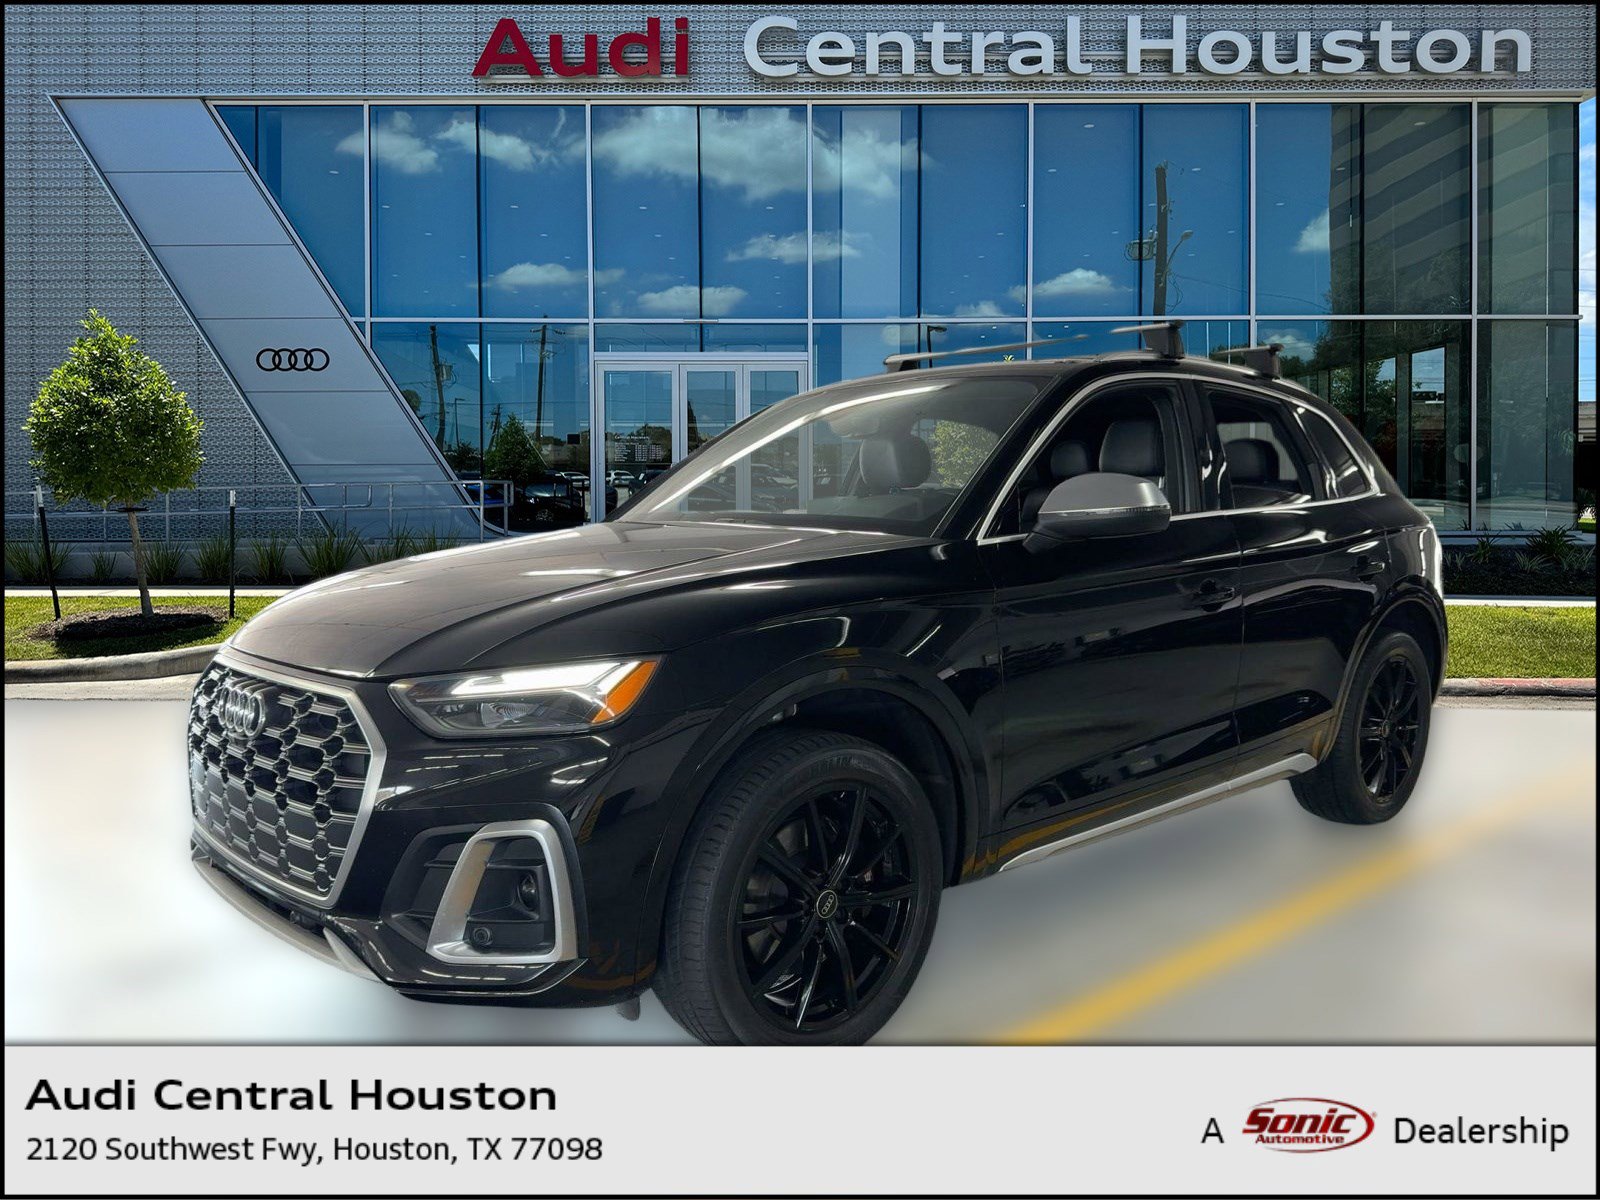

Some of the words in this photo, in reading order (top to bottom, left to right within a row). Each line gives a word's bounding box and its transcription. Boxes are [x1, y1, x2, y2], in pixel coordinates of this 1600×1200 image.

[472, 17, 690, 78] Audi
[743, 15, 1092, 78] Central
[1126, 15, 1532, 77] Houston
